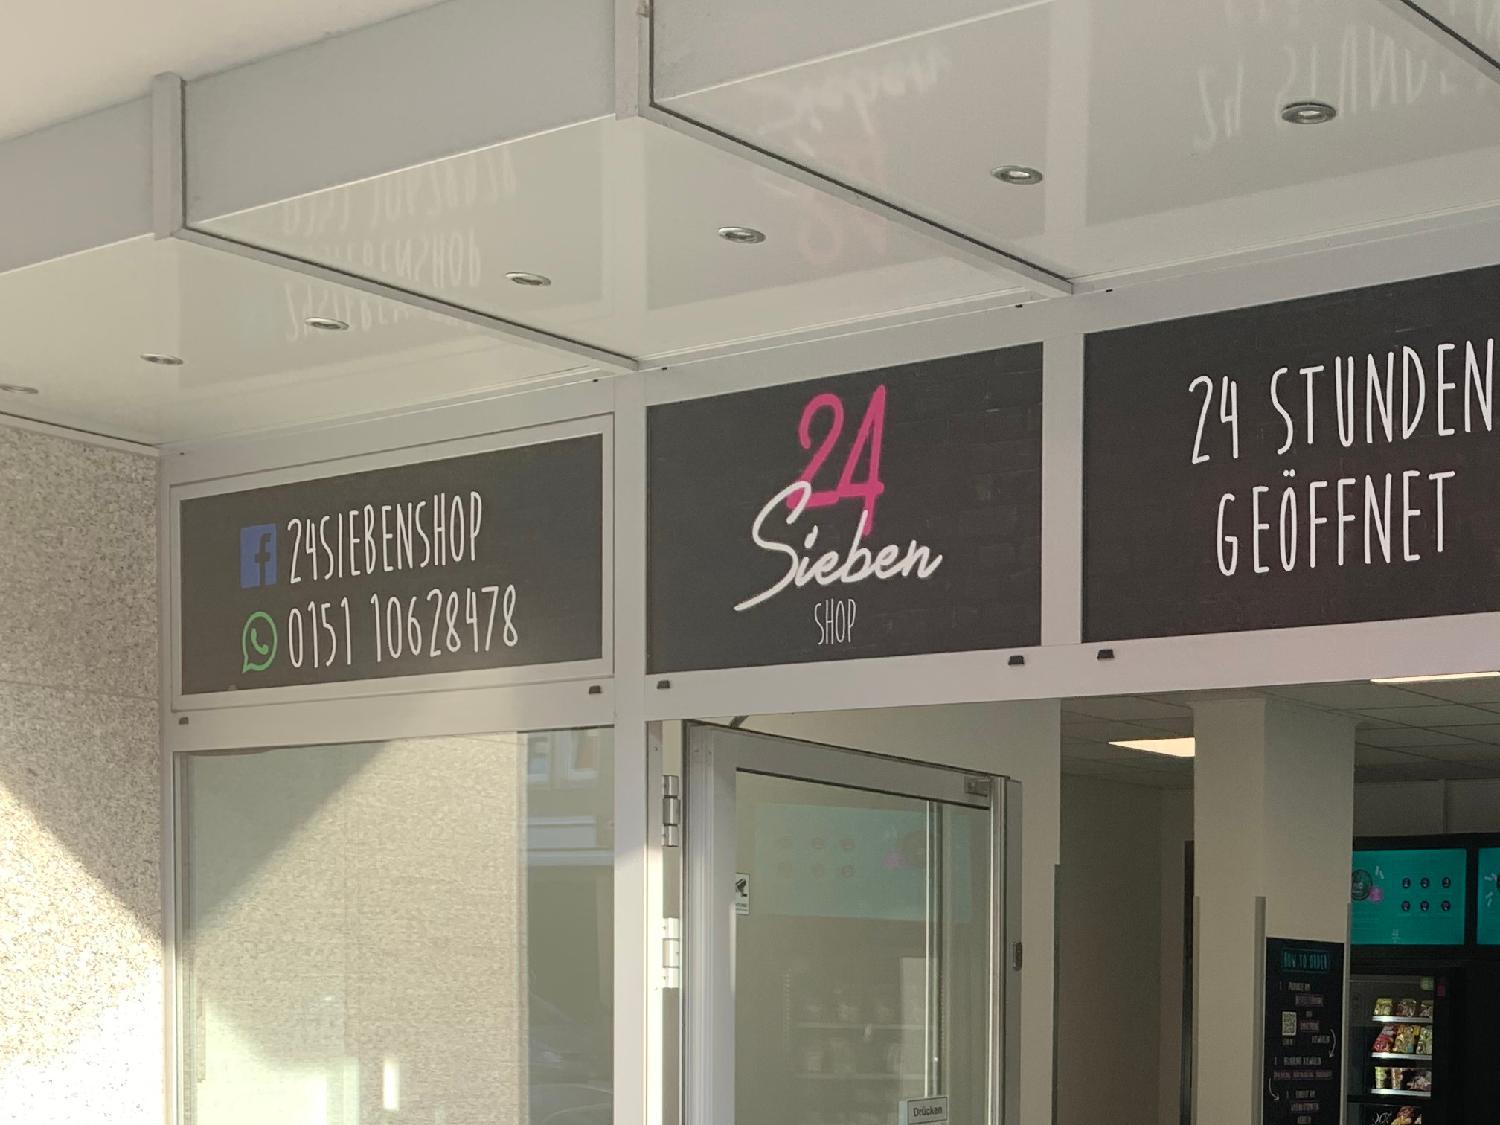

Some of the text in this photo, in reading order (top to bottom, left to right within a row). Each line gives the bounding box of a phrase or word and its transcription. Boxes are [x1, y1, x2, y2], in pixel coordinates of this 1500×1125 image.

[1189, 338, 1494, 464] 24 STUNDEN
[785, 384, 887, 538] 24
[287, 491, 484, 587] 24SIEBENSHOP
[735, 481, 943, 611] Sieben
[1216, 469, 1455, 577] GEÖFFNET
[287, 584, 520, 671] 0151 10628478
[814, 599, 857, 647] SHOP
